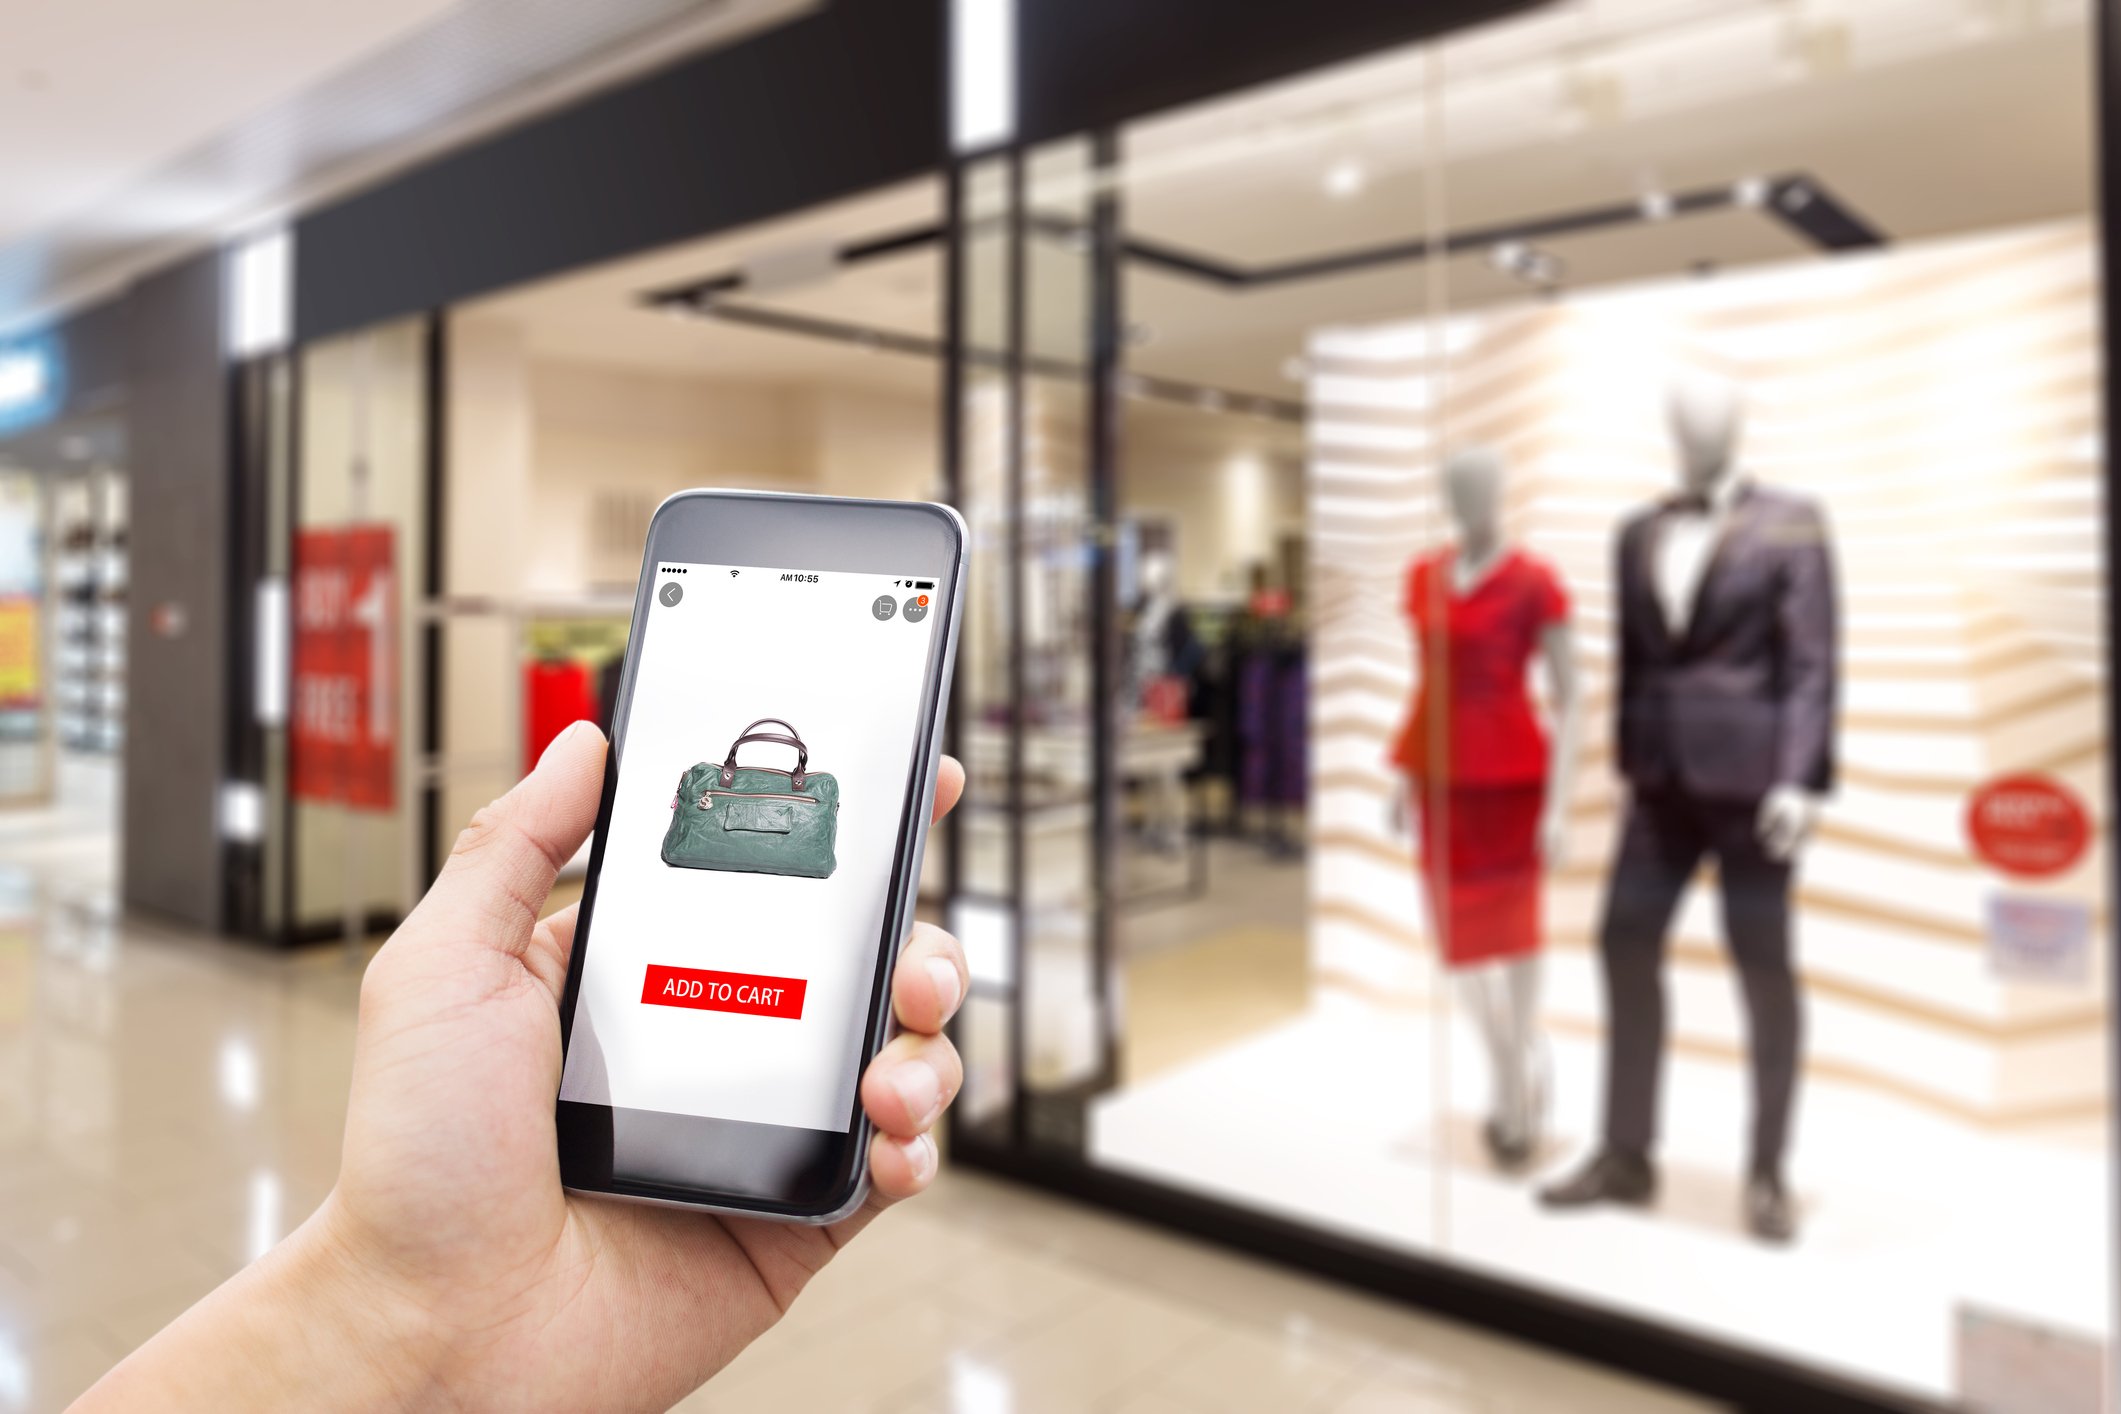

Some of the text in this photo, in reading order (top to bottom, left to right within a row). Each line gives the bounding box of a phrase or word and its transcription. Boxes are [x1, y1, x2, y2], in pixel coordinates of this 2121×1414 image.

[662, 978, 785, 1007] ADD TO CART
